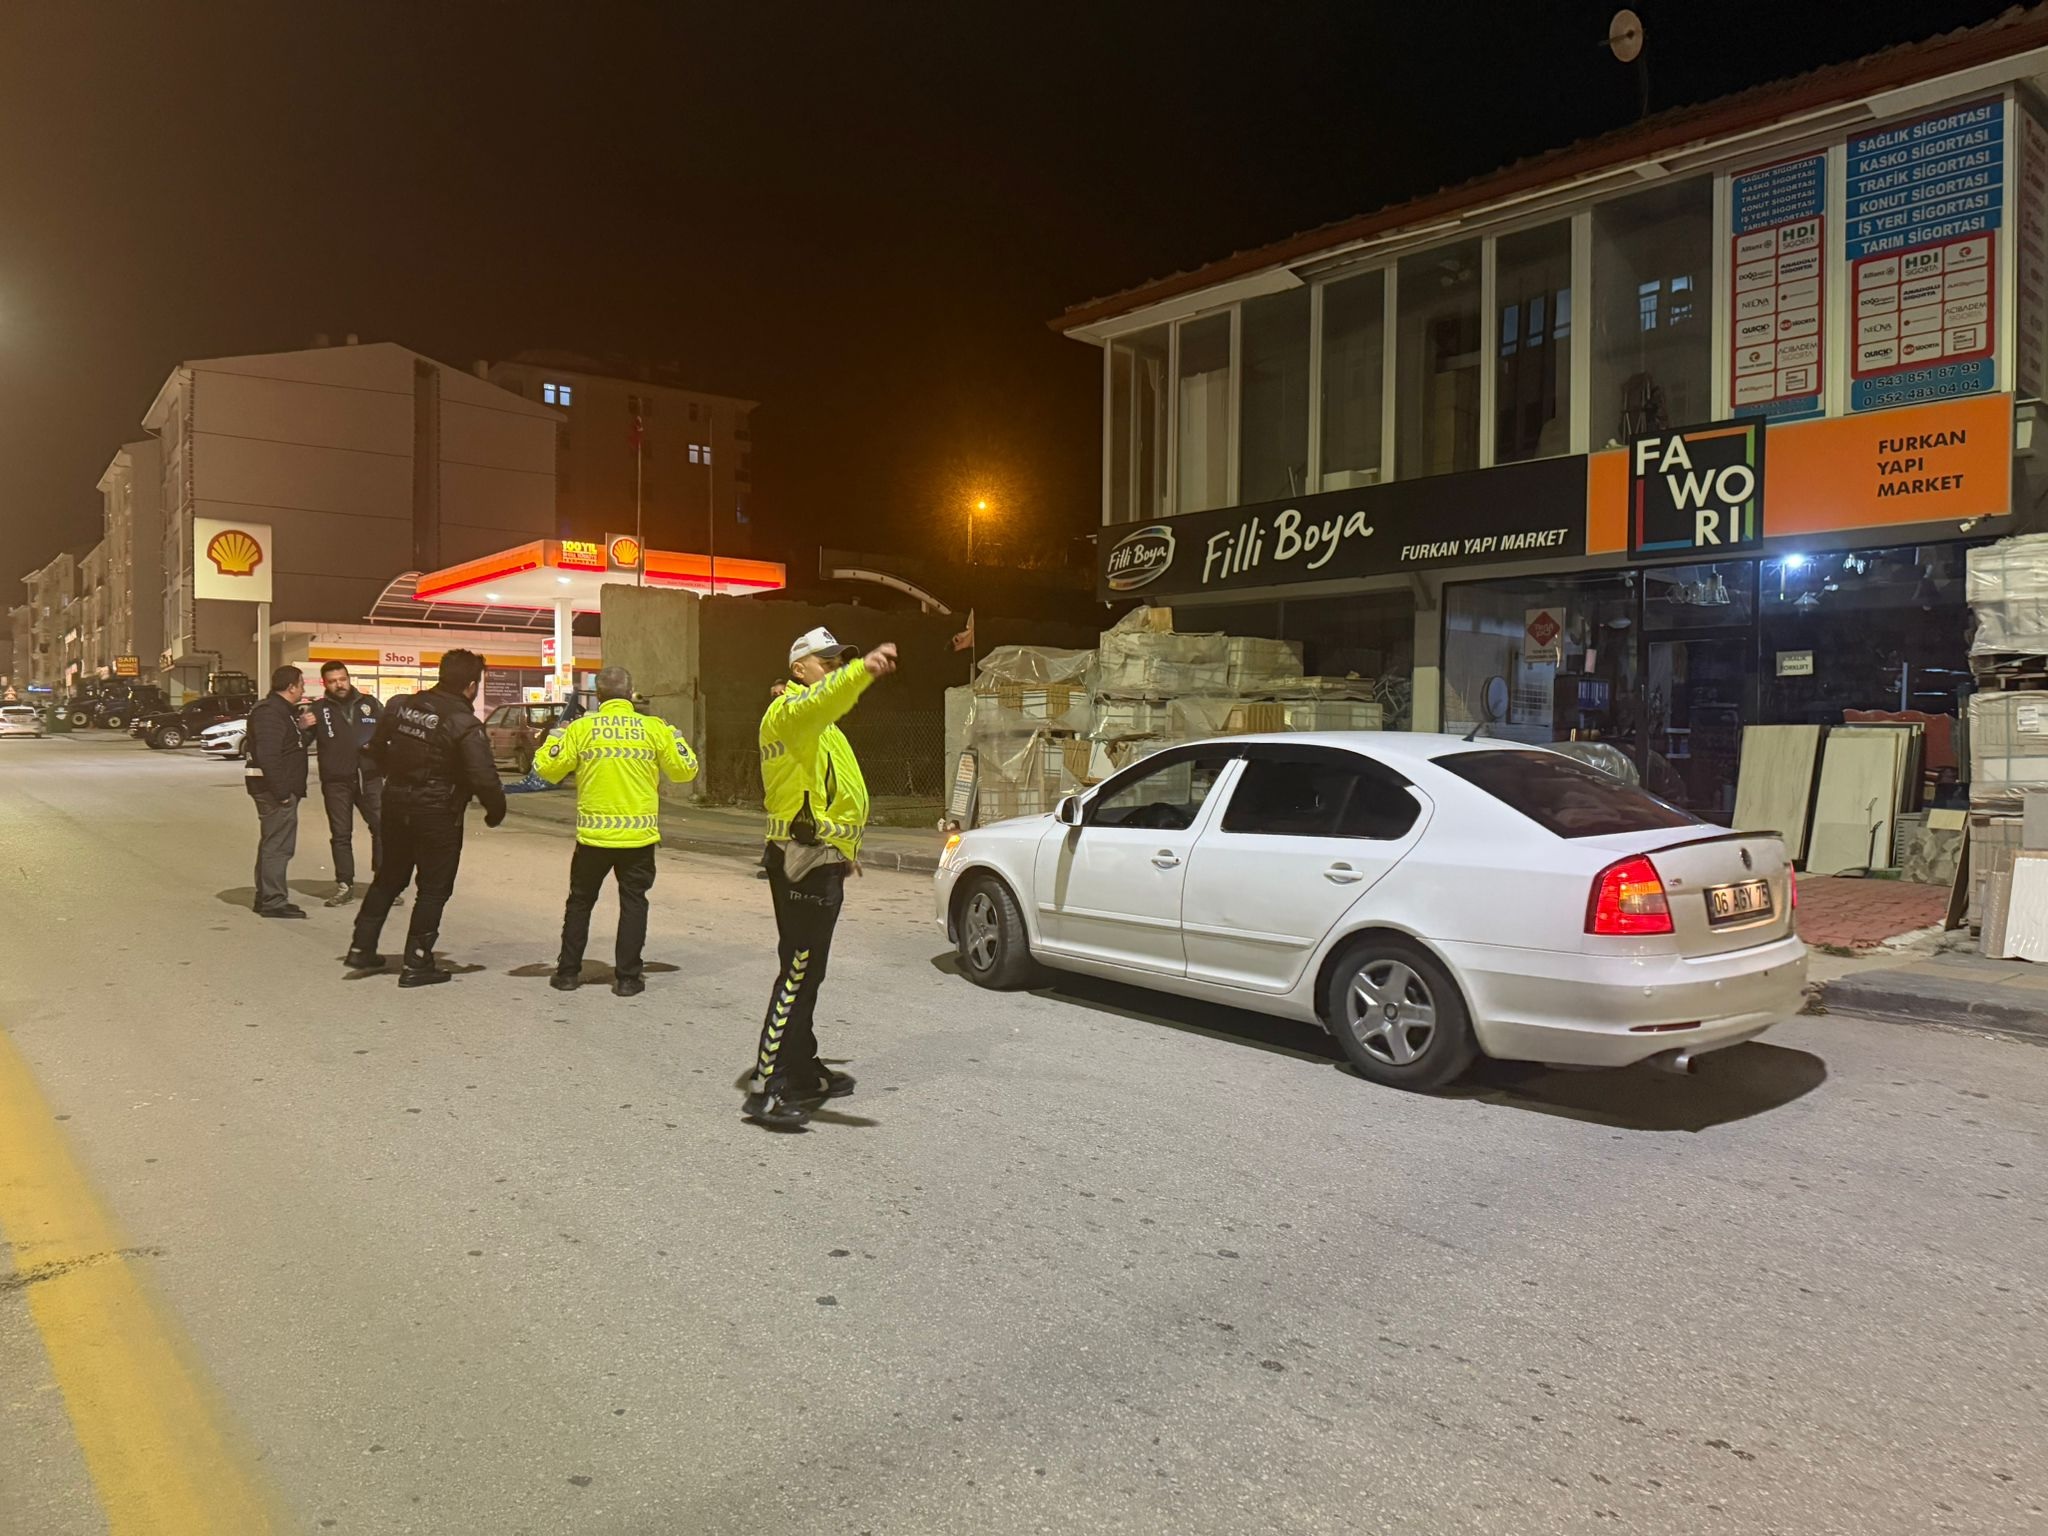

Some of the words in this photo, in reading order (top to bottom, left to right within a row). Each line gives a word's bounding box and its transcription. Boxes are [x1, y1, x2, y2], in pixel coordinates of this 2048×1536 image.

[1858, 130, 1909, 152] SAĞLIK
[1913, 106, 1991, 138] SİGORTASI
[1860, 152, 1907, 173] KASKO
[1911, 129, 1989, 160] SİGORTASI
[1858, 171, 1909, 193] TRAFİK
[1913, 151, 1990, 180] SİGORTASI
[1859, 192, 1908, 214] KONUT
[1912, 172, 1989, 201] SİGORTASI
[1859, 221, 1872, 236] İŞ
[1876, 211, 1908, 230] YERİ
[1912, 194, 1989, 222] SİGORTASI
[1782, 224, 1815, 241] HDI
[1862, 235, 1904, 255] TARIM
[1908, 216, 1985, 244] SİGORTASI
[1905, 252, 1939, 269] HDI
[1864, 380, 1872, 390] 0
[1877, 376, 1903, 388] 543
[1908, 370, 1933, 383] 851
[1939, 366, 1956, 378] 87
[1961, 362, 1980, 374] 99
[1864, 397, 1872, 406] 0
[1877, 392, 1902, 404] 552
[1908, 387, 1933, 399] 483
[1939, 383, 1955, 396] 04
[1961, 380, 1979, 391] 04
[1636, 434, 1692, 476] FA
[1878, 429, 1967, 455] FURKAN
[1877, 457, 1924, 476] YAPI
[1666, 464, 1755, 510] WO
[1877, 474, 1964, 498] MARKET
[1695, 506, 1740, 546] RI
[562, 541, 581, 552] 100
[1107, 549, 1133, 572] Filli
[1133, 544, 1167, 568] Boya
[1202, 517, 1266, 584] Filli
[1273, 509, 1374, 569] Boya
[1400, 540, 1460, 561] FURKAN
[1464, 536, 1498, 554] YAPI
[1500, 528, 1568, 551] MARKET
[385, 652, 414, 664] Shop
[591, 715, 643, 728] TRAFİK
[1713, 892, 1728, 914] 06
